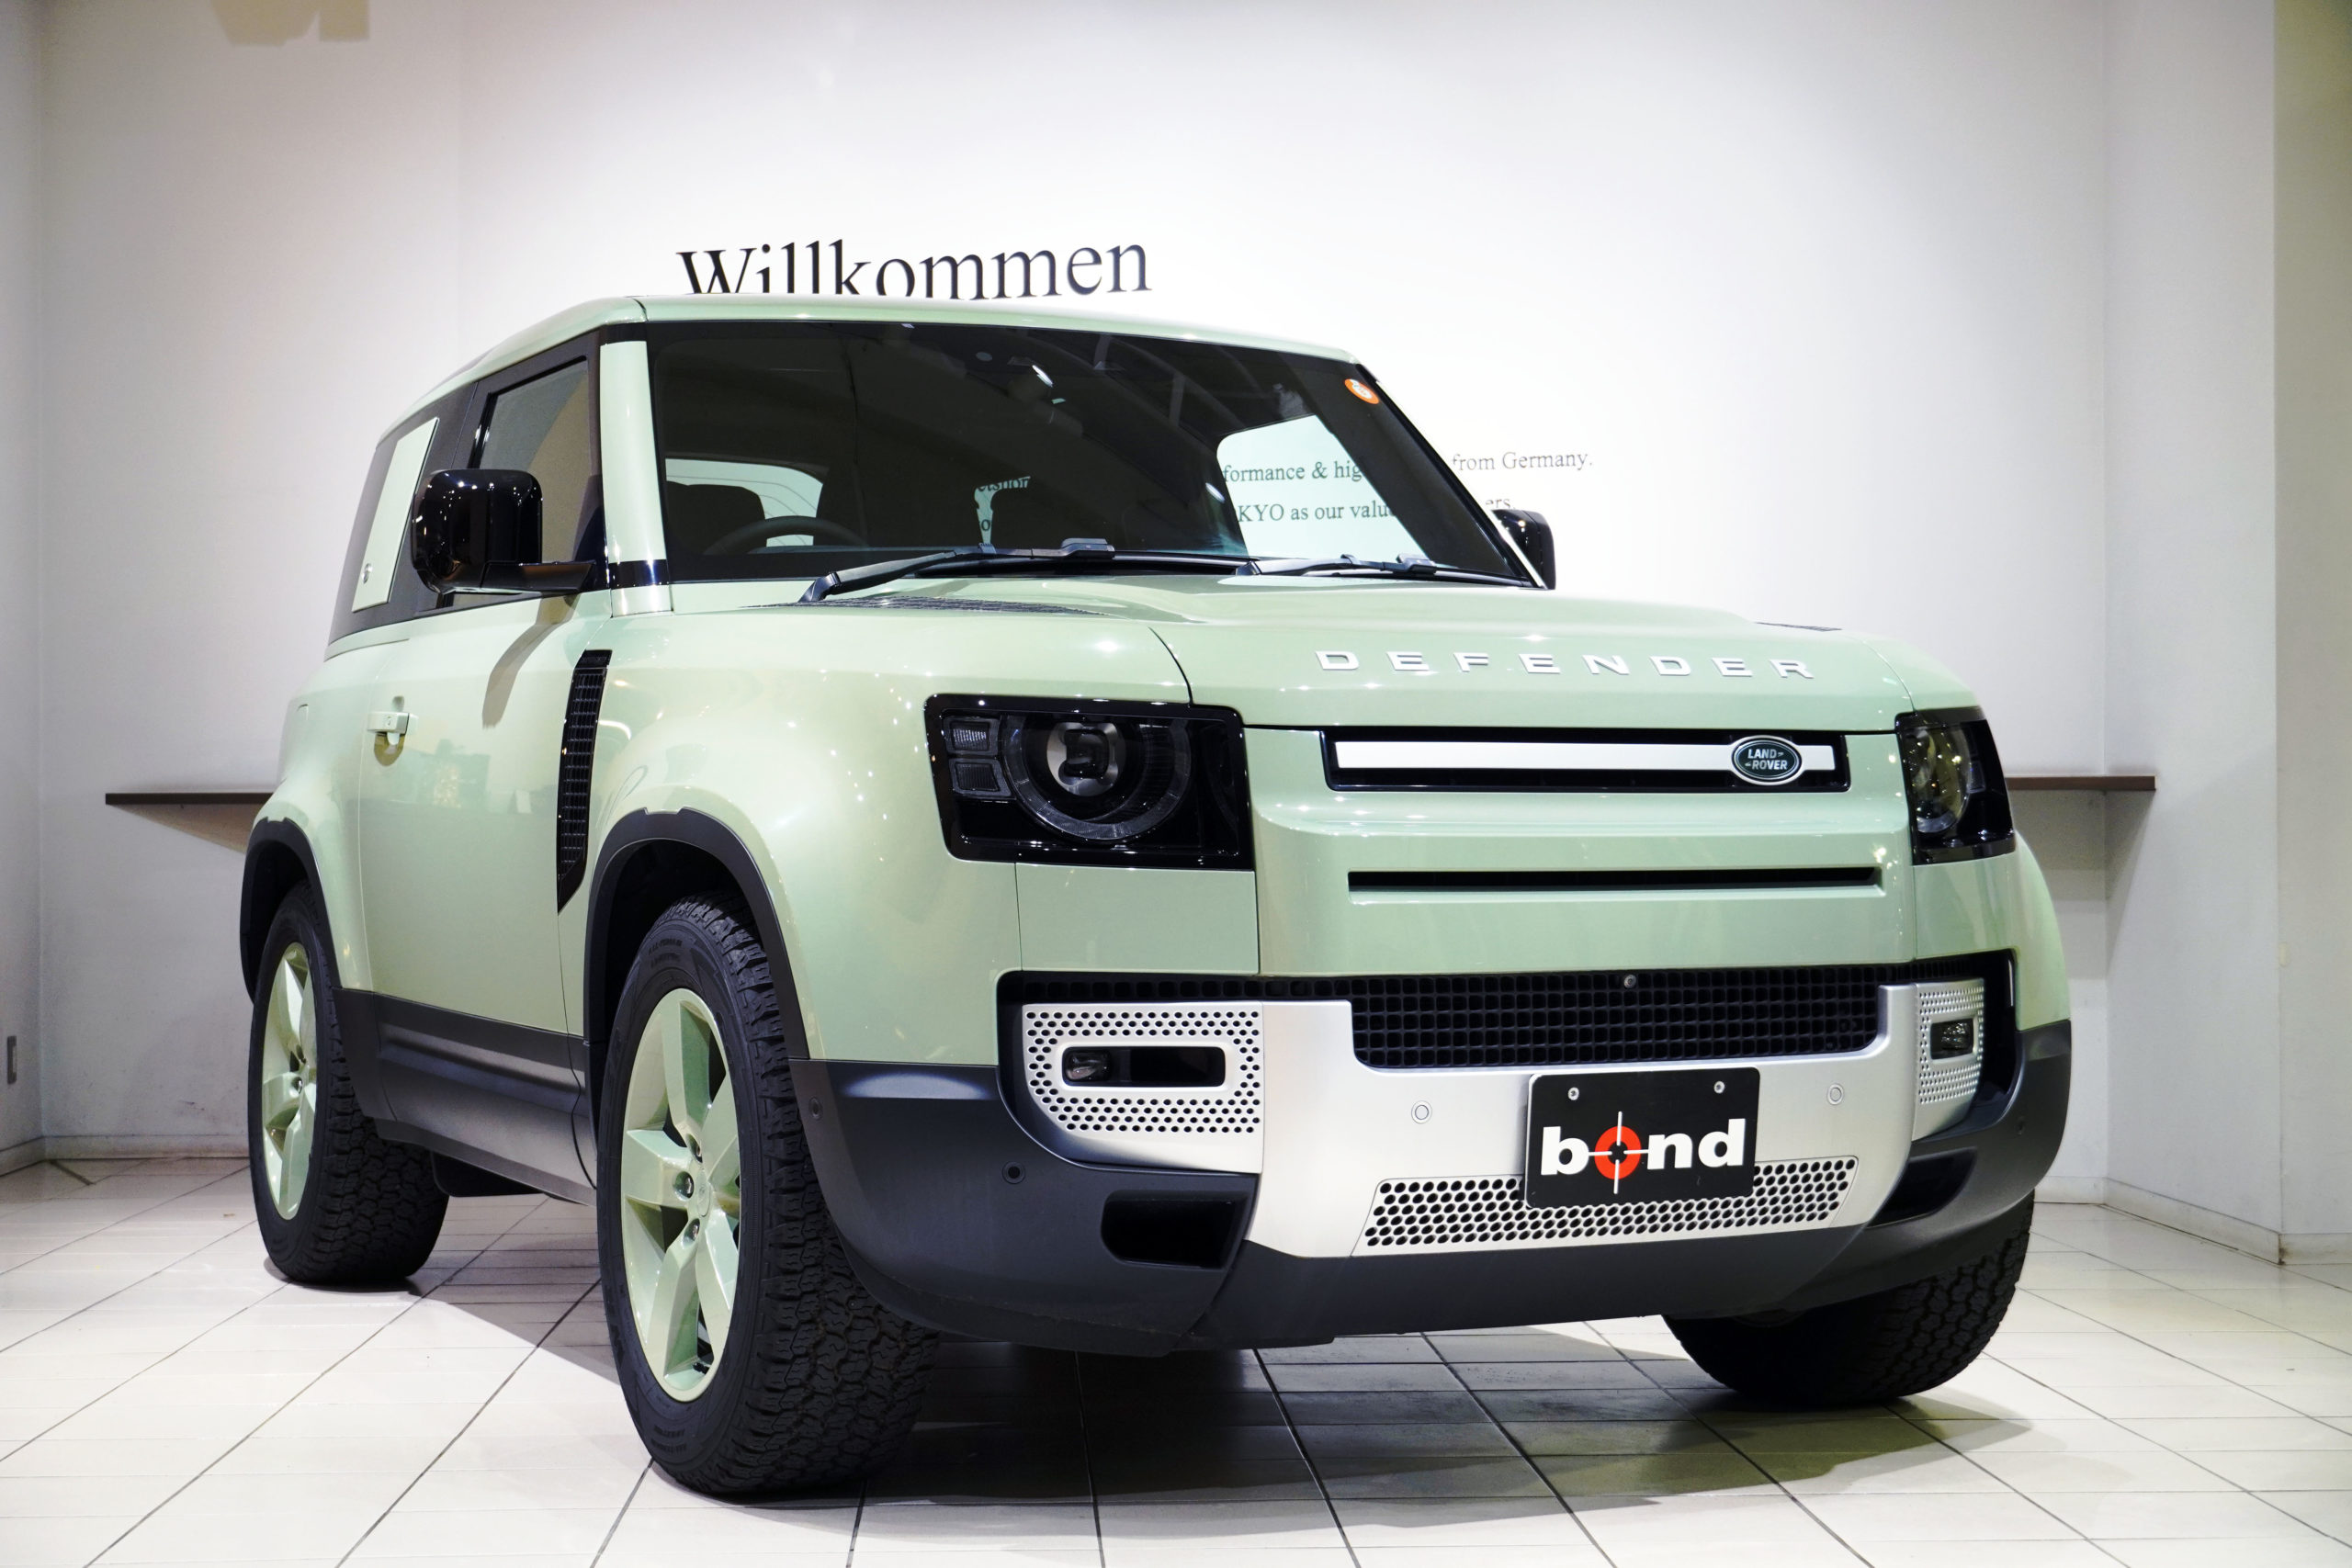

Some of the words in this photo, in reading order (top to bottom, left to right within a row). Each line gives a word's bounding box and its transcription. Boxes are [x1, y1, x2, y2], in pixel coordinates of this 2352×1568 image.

[675, 238, 1153, 300] Willkommen
[1223, 464, 1306, 482] formance
[1312, 461, 1328, 479] &
[1333, 460, 1363, 482] hig
[1453, 453, 1496, 471] from
[1502, 451, 1593, 471] Germany.
[1238, 504, 1284, 522] KYO
[1291, 508, 1308, 521] as
[1315, 505, 1344, 520] our
[1315, 650, 1814, 680] DEFENDER
[1747, 749, 1777, 759] LAND
[1752, 760, 1788, 770] ROVER
[1541, 1118, 1746, 1180] bond
